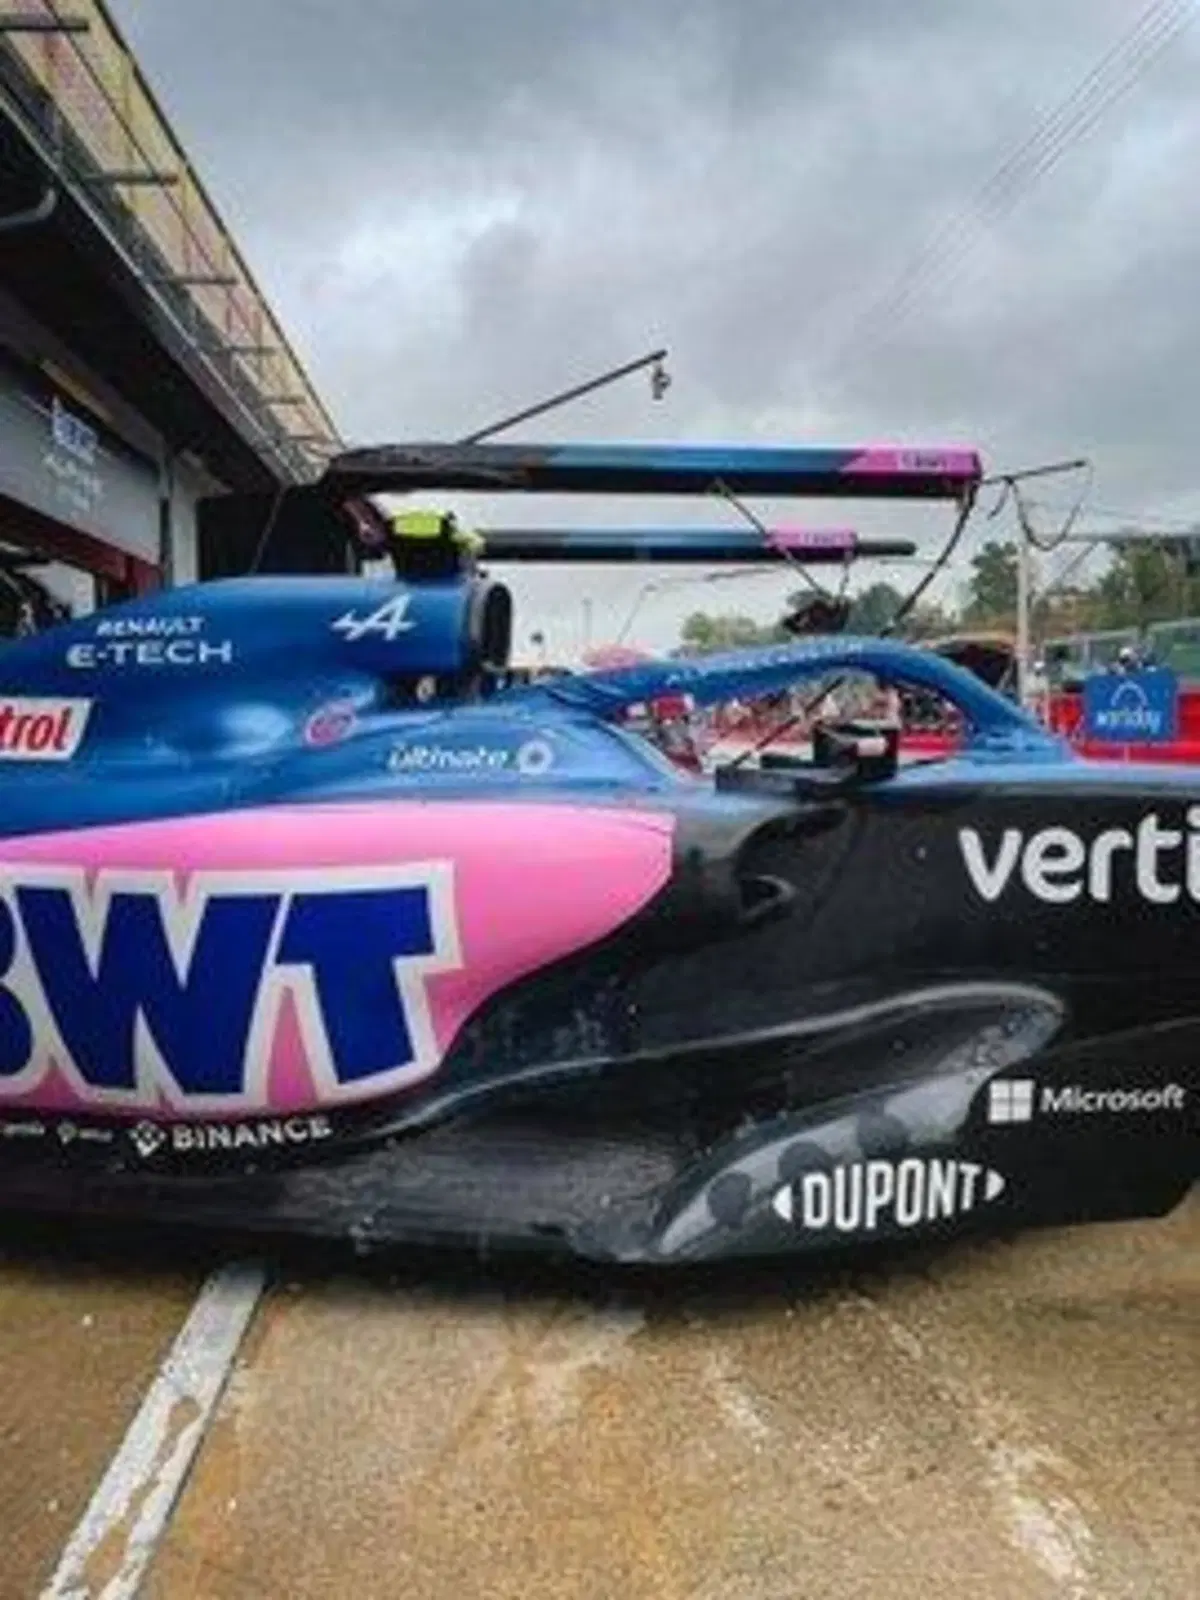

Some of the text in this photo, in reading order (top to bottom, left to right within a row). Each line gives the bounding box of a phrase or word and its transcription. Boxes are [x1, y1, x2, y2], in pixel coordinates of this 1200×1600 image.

[97, 616, 205, 637] RENAULT
[66, 640, 233, 668] E-TECH
[1039, 1084, 1185, 1112] Microsoft
[172, 1117, 333, 1150] BINANCE
[803, 1158, 983, 1231] DUPONT
